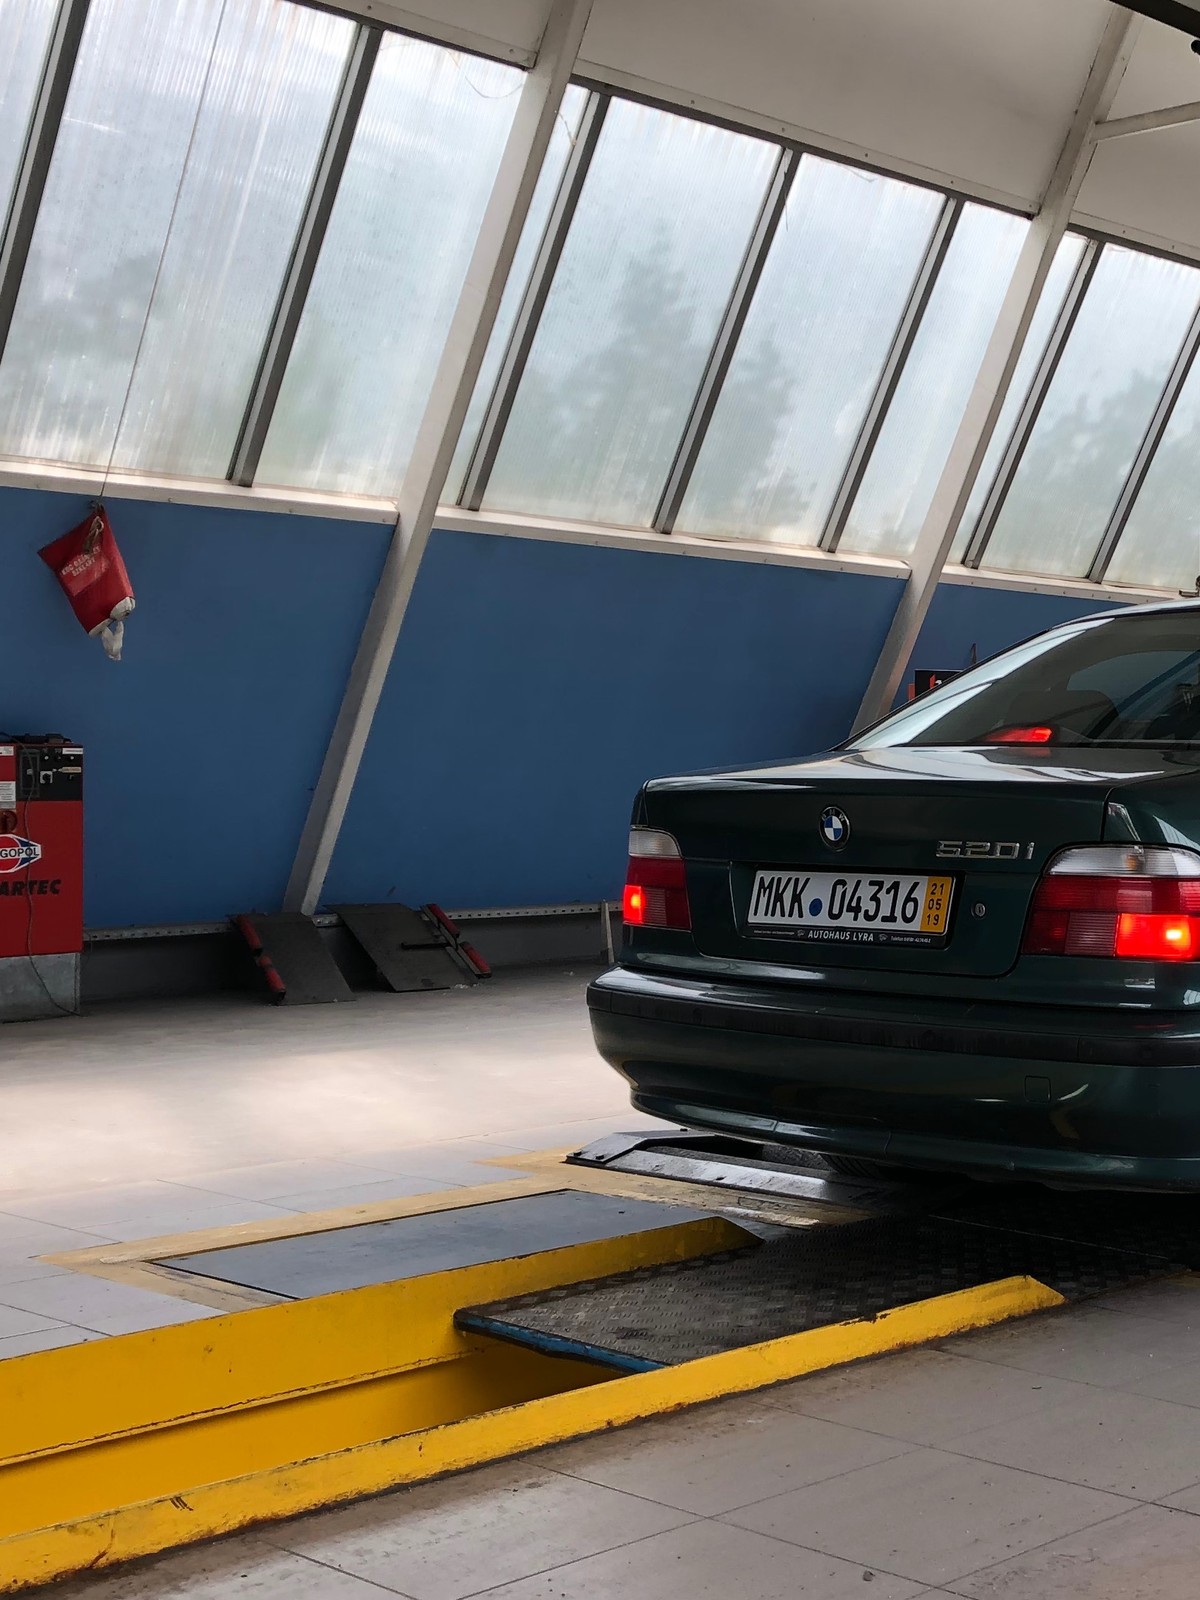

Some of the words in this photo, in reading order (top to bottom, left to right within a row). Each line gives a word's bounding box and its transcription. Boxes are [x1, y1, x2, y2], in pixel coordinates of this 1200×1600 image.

[936, 841, 1035, 859] 520i
[930, 883, 945, 895] 21
[754, 876, 811, 918] MKK
[828, 878, 920, 924] 04316
[928, 899, 942, 911] 05
[926, 913, 940, 926] 19
[808, 930, 850, 940] AUTOHAUS
[853, 932, 874, 942] LYRA
